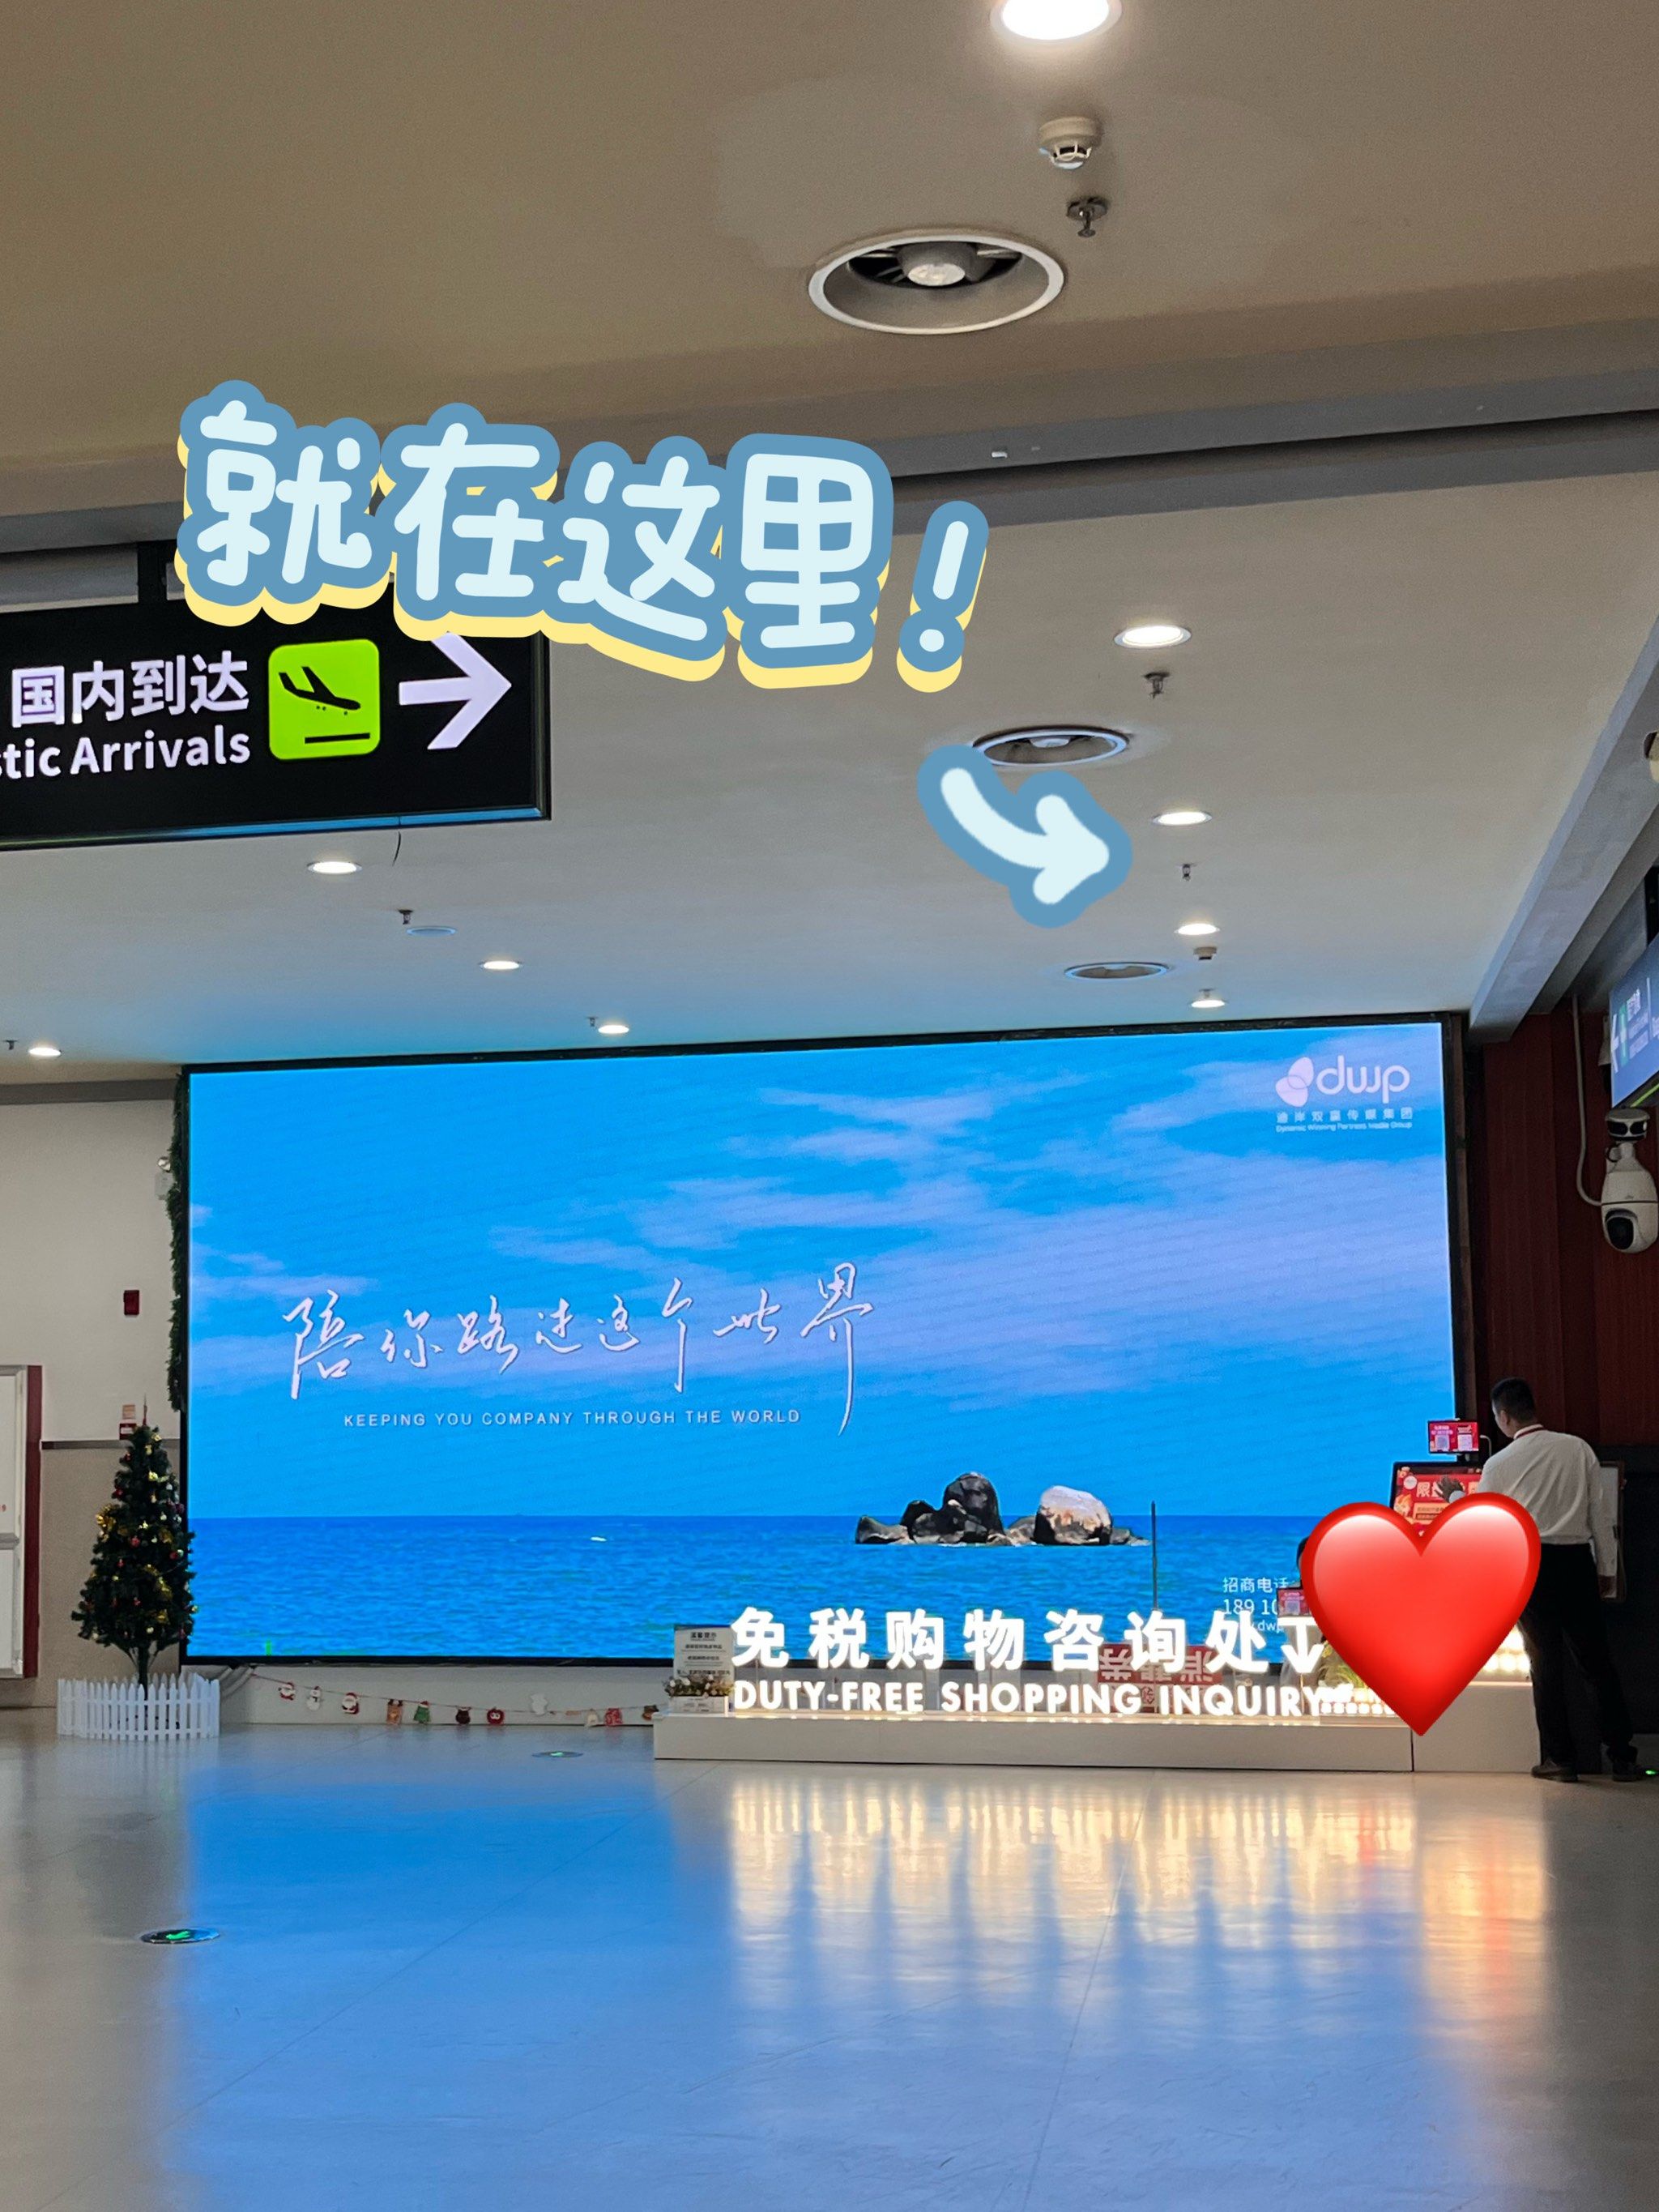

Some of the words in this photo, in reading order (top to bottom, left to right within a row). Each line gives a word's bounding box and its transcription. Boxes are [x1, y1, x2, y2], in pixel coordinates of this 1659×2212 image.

[11, 650, 249, 728] 国内到达
[0, 737, 62, 779] tic
[70, 724, 251, 775] Arrivals
[1316, 1055, 1410, 1104] dwp
[343, 1414, 426, 1427] KEEPING
[435, 1413, 473, 1426] YOU
[482, 1412, 573, 1425] COMPANY
[583, 1411, 676, 1424] THROUGH
[684, 1411, 722, 1424] THE
[731, 1410, 801, 1424] WORLD
[731, 1606, 1268, 1674] 免税购物咨询处
[734, 1680, 924, 1712] DUTY-FREE
[940, 1681, 1143, 1715] SHOPPING
[1159, 1685, 1324, 1716] INQUIRY
